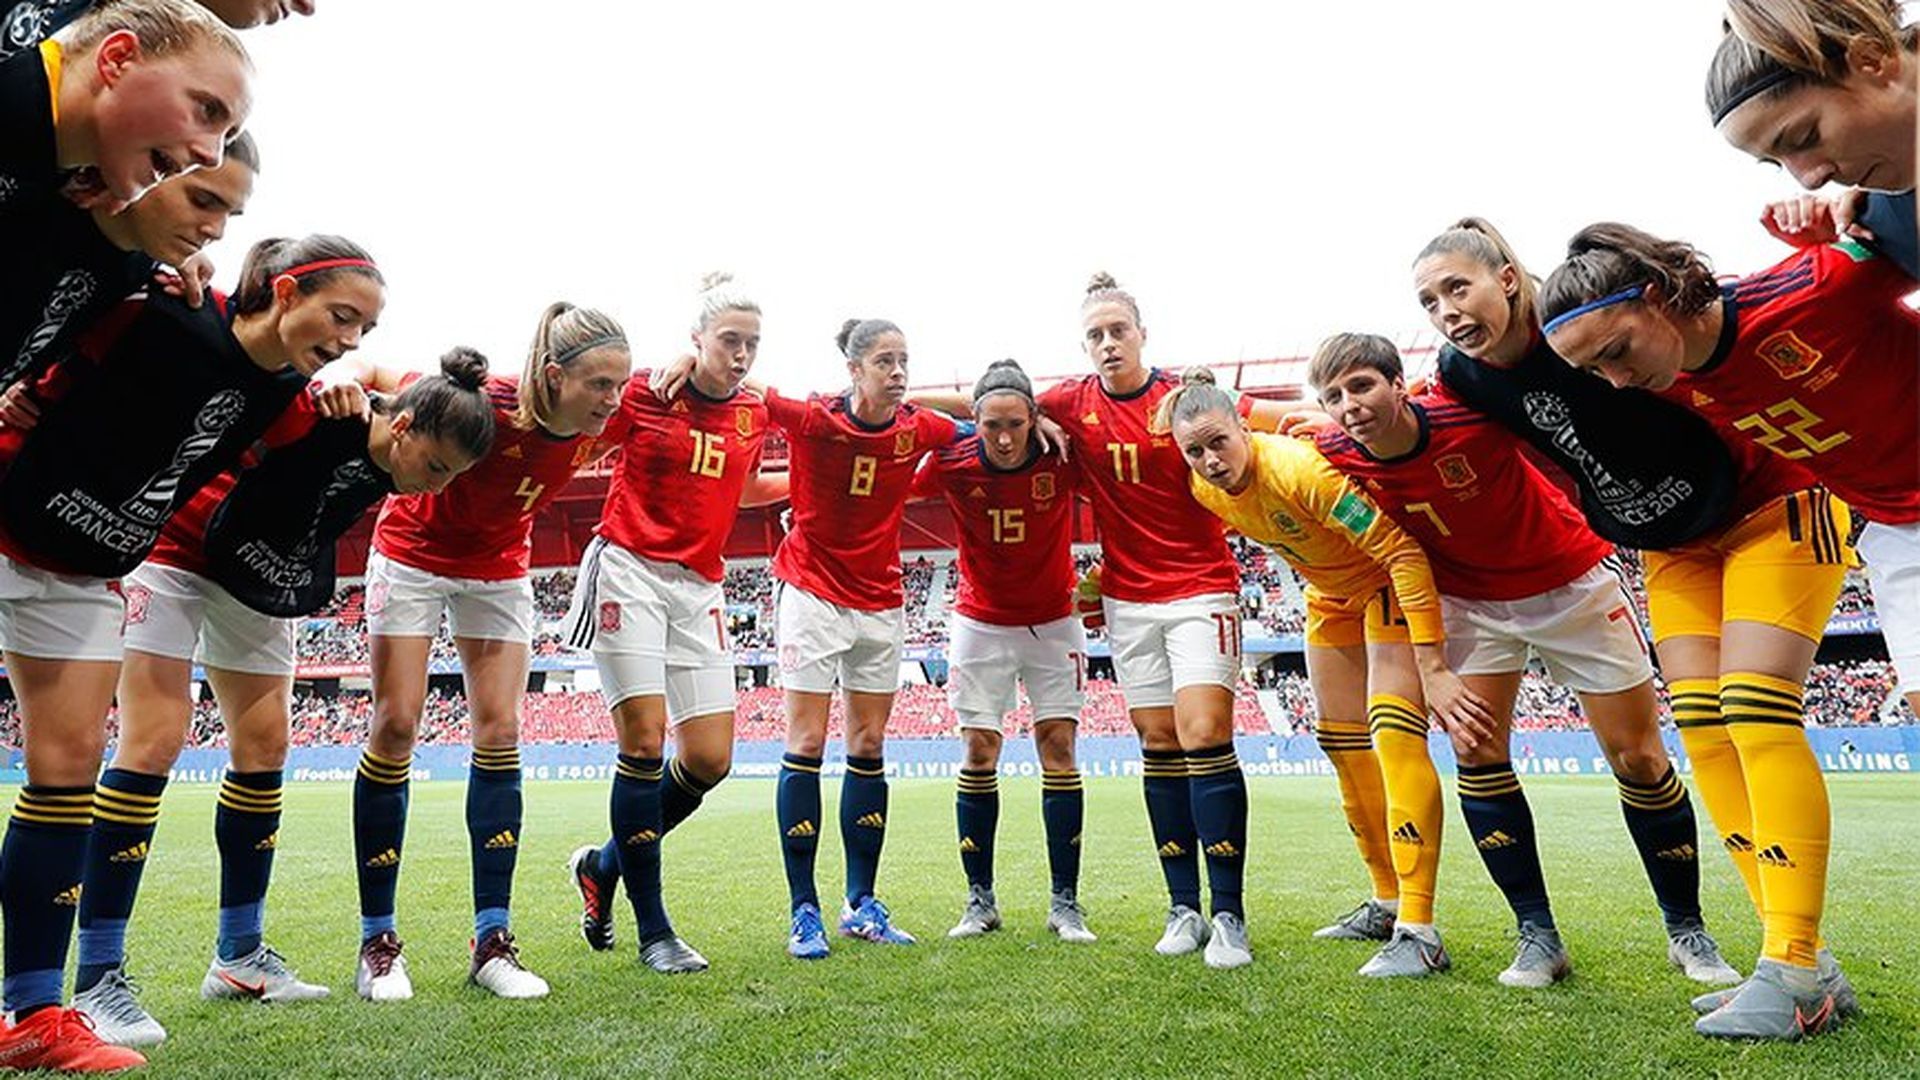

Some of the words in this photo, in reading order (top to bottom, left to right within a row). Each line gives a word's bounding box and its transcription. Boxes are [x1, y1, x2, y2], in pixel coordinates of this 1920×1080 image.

[1732, 398, 1851, 460] 22
[688, 429, 726, 479] 16
[1106, 443, 1140, 484] 11
[514, 476, 545, 512] 4
[850, 455, 877, 496] 8
[1648, 479, 1694, 517] 2019
[45, 491, 139, 554] FRANCE
[987, 508, 1026, 543] 15
[1404, 502, 1450, 537] 7
[1210, 612, 1239, 658] 11
[1607, 606, 1648, 655] 7
[903, 762, 961, 778] LIVIN
[1825, 752, 1911, 770] LIVING
